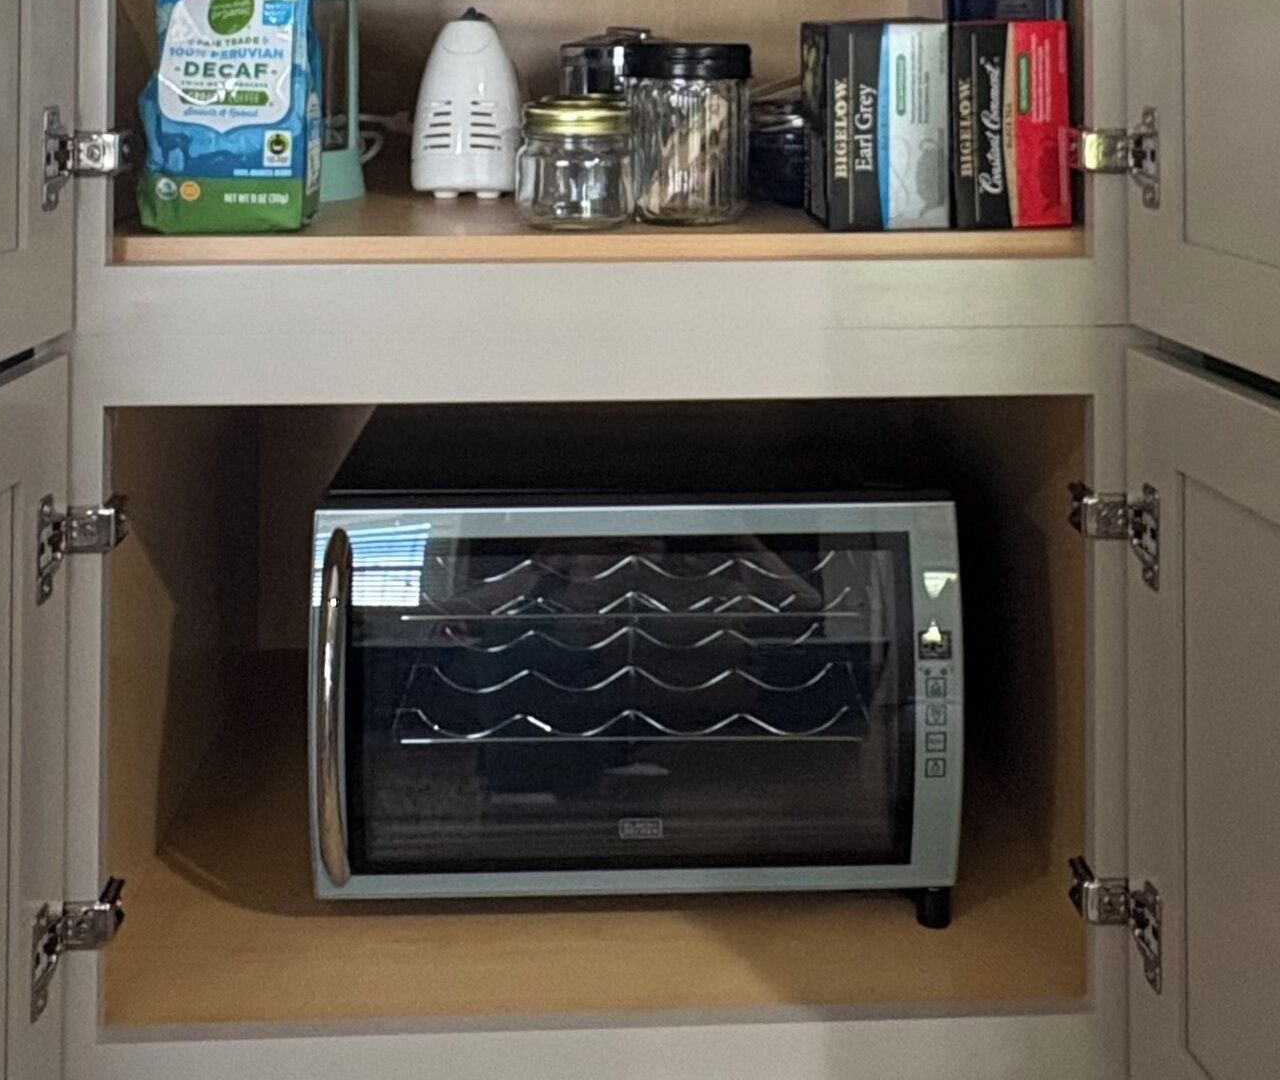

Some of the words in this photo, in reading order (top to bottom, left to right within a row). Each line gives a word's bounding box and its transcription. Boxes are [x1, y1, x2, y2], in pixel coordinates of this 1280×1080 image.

[183, 61, 269, 79] DECAF
[834, 77, 848, 178] BIGELOW
[855, 82, 877, 130] Grey
[959, 77, 973, 177] BIGELOW
[855, 131, 873, 171] Earl
